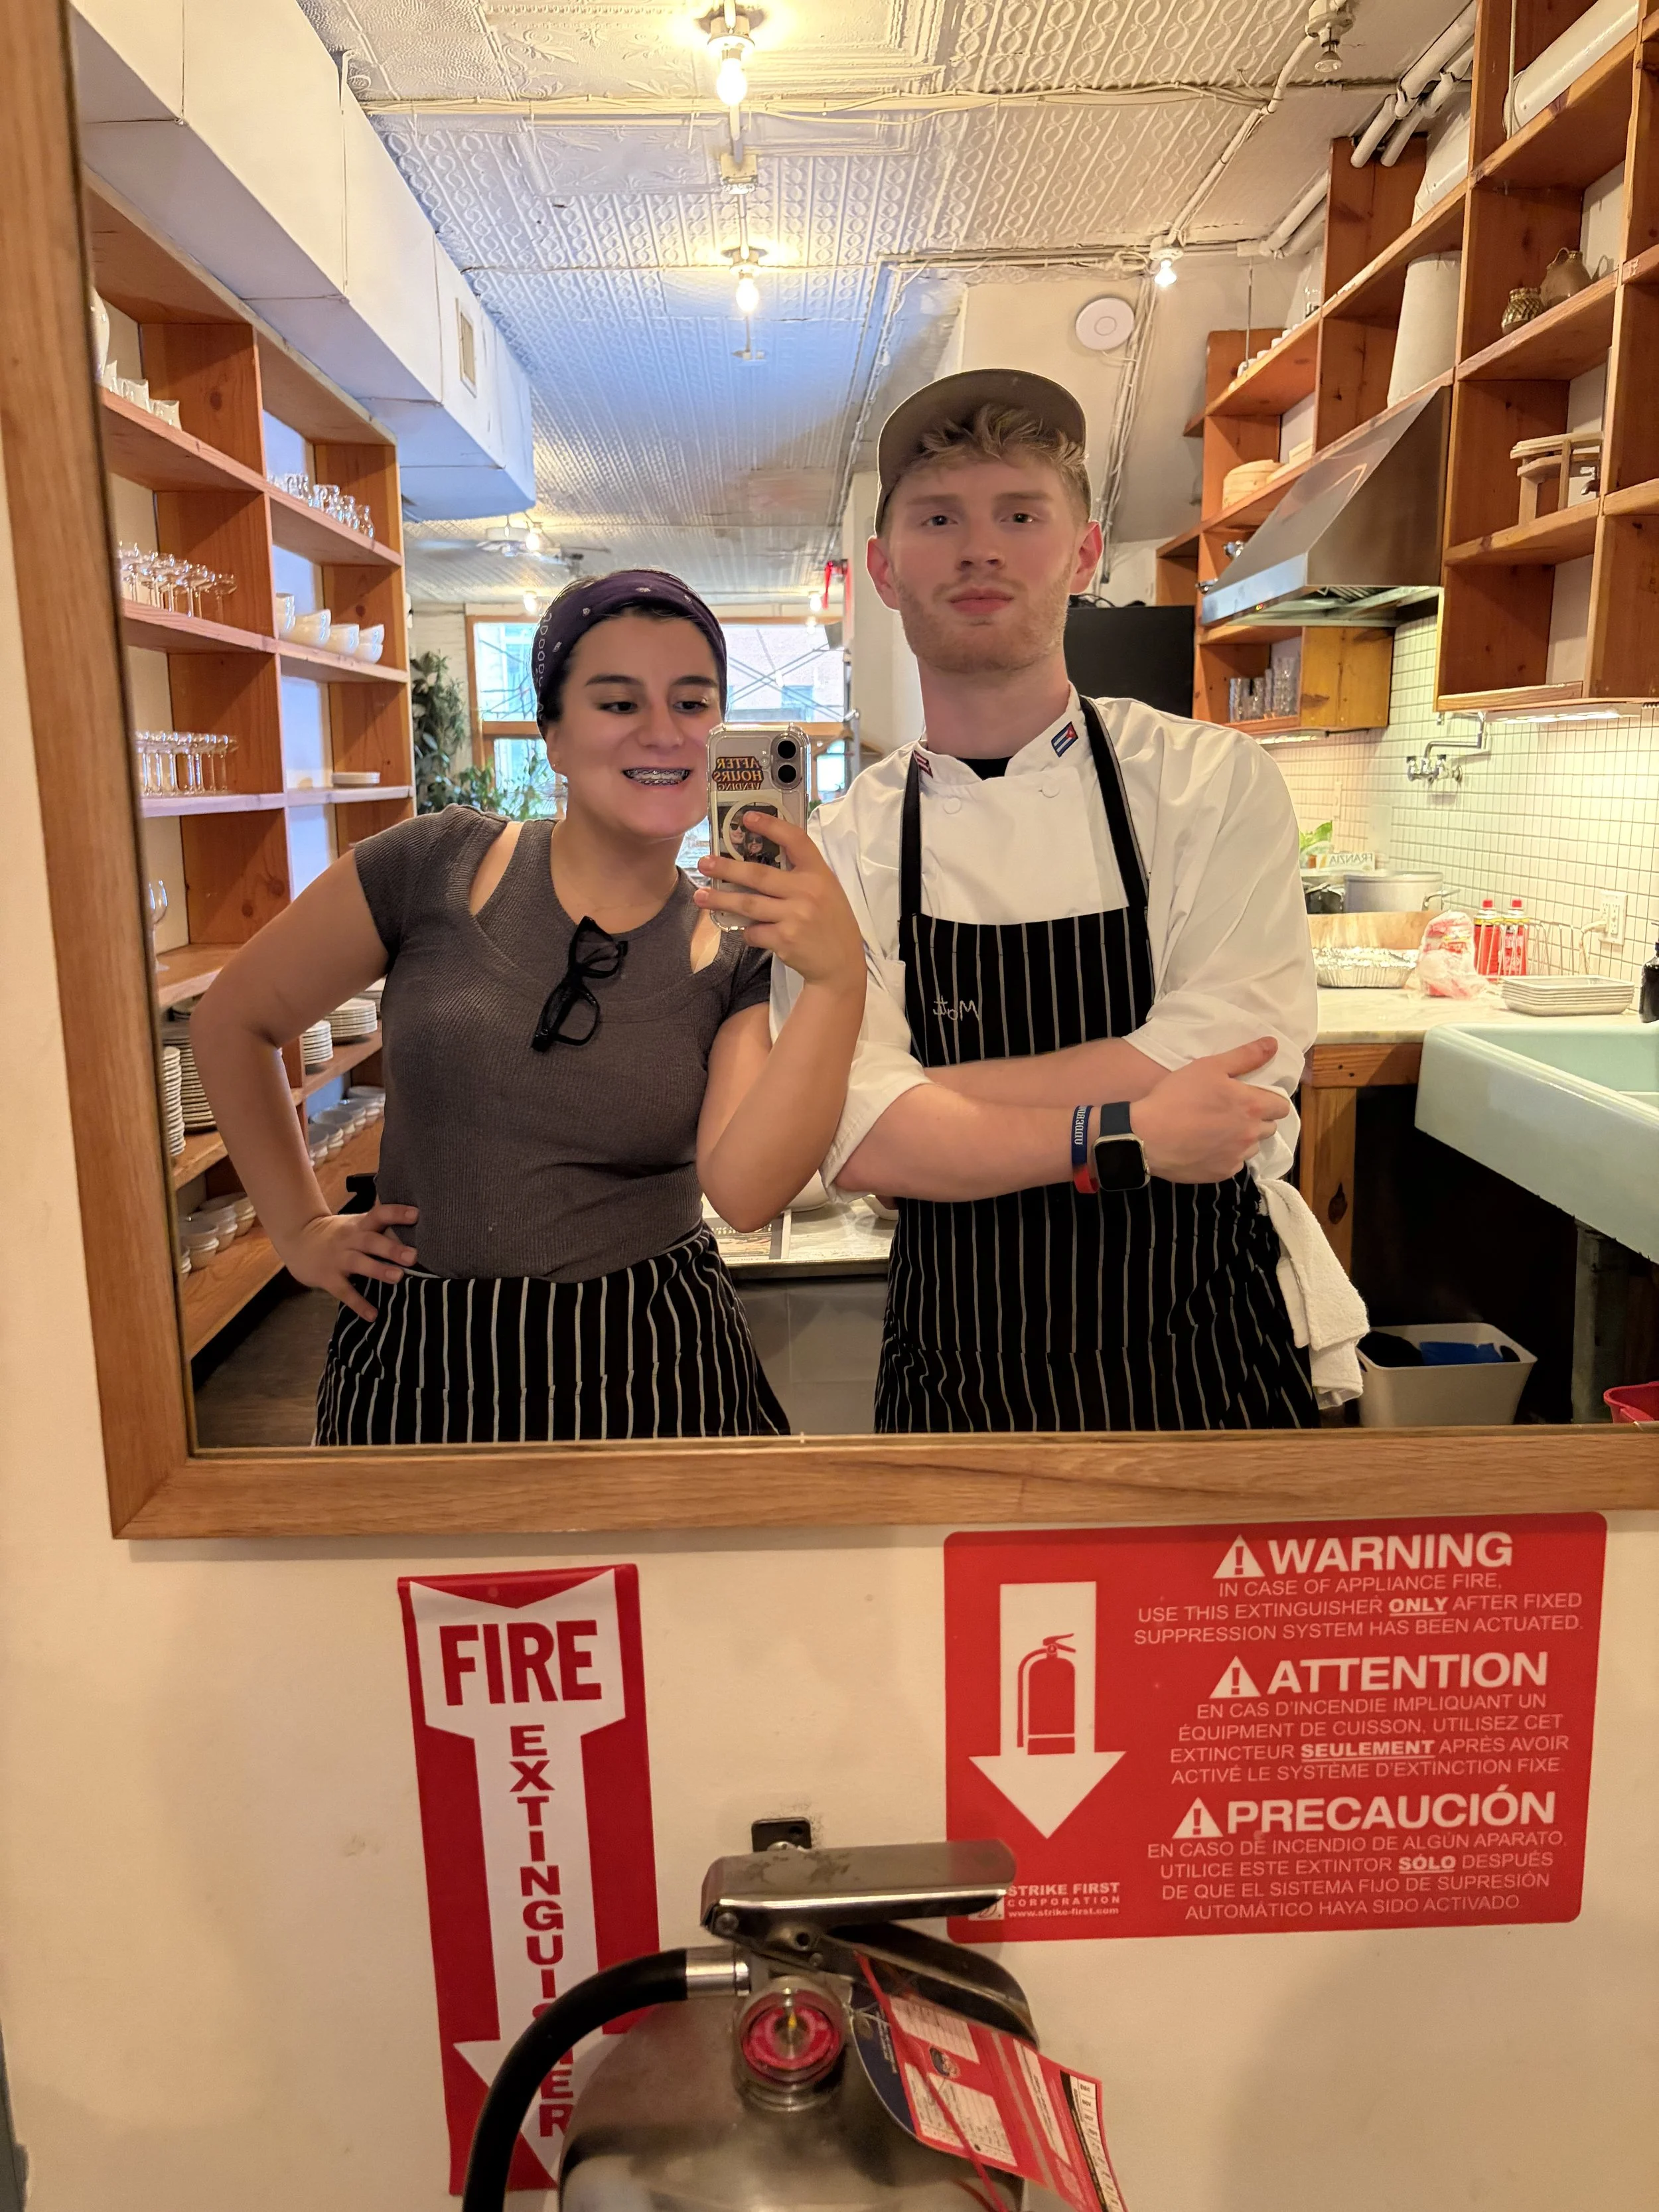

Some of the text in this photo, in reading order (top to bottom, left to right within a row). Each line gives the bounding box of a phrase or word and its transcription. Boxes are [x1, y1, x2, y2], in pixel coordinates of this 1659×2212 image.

[1270, 1533, 1511, 1573] WARNING
[1220, 1573, 1501, 1597] IN CASE OF APPLIANCE FIRE,
[1139, 1593, 1582, 1624] USE THIS EXTINGUISHER ONLY AFTER FIXED
[1135, 1615, 1582, 1645] SUPPRESSION SYSTEM HAS BEEN ACTUATED.
[439, 1620, 602, 1706] FIRE
[1269, 1653, 1546, 1693] ATTENTION
[1197, 1694, 1546, 1719] EN CAS D'INCENDIE IMPLIQUANT UN
[1301, 1722, 1326, 1737] DE
[1333, 1719, 1425, 1735] CUISSON,
[1434, 1716, 1518, 1732] UTILISEZ
[1525, 1714, 1563, 1730] CET
[1171, 1735, 1569, 1763] EXTINCTEUR SEULEMENT APRÈS AVOIR
[1171, 1765, 1242, 1785] ACTIVÉ
[1248, 1767, 1270, 1782] LE
[1277, 1762, 1369, 1781] SYSTÈME
[1376, 1759, 1511, 1777] D'EXTINCTION
[1229, 1785, 1554, 1832] PRECAUCIÓN
[1148, 1843, 1173, 1859] EN
[1180, 1842, 1234, 1858] CASO
[1241, 1838, 1266, 1856] DE
[1273, 1837, 1366, 1854] INCENDIO
[1372, 1836, 1398, 1851] DE
[1403, 1832, 1469, 1850] ALGÚN
[1161, 1850, 1553, 1880] UTILICE ESTE EXTINTOR SÓLO DESPUÉS
[1008, 1882, 1120, 1897] STRIKE FIRST
[1163, 1872, 1550, 1901] DE QUE EL SISTEMA FIJO DE SUPRESIÓN
[1007, 1895, 1120, 1907] CORPORATION
[1008, 1907, 1119, 1918] www.strike-first.com
[1185, 1895, 1519, 1920] AUTOMÁTICO HAYA SIDO ACTIVADO
[509, 1724, 574, 2138] EXTINGUIER
